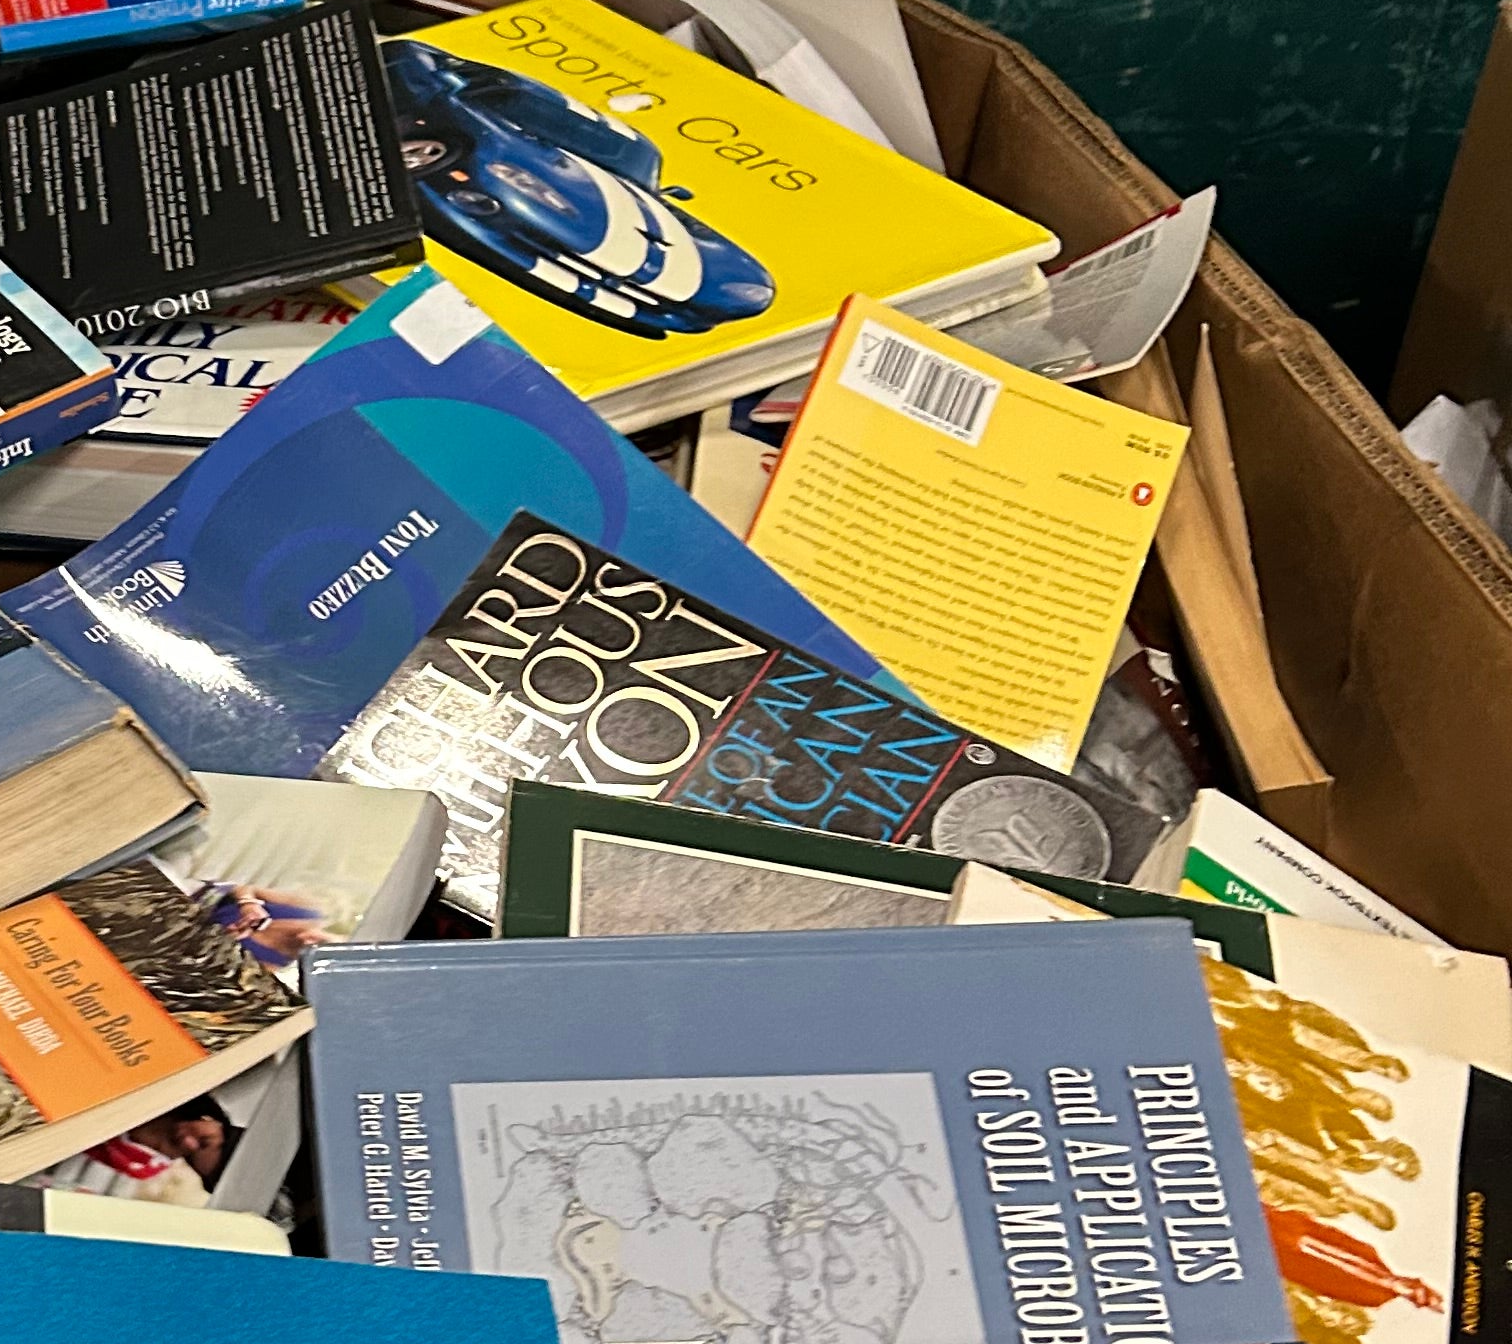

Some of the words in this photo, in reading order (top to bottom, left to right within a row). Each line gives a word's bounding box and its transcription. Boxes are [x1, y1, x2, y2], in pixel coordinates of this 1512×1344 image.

[678, 117, 818, 192] Cars
[153, 288, 211, 320] BIO
[378, 510, 439, 558] TONI
[100, 567, 154, 609] Book
[308, 550, 392, 621] BUZZEO
[338, 533, 587, 783] ICHARD
[757, 653, 830, 729] AN
[1224, 881, 1278, 912] orld
[7, 918, 60, 970] Caring
[43, 960, 83, 990] For
[64, 982, 111, 1021] Your
[93, 1014, 153, 1067] Books
[15, 1017, 64, 1055] DIRDA
[968, 1068, 1024, 1101] of
[1049, 1065, 1117, 1128] and
[357, 1093, 385, 1136] Peter
[395, 1092, 428, 1140] David
[363, 1143, 390, 1160] G.
[401, 1145, 431, 1165] M.
[978, 1109, 1053, 1193] SOIL
[1127, 1063, 1245, 1286] PRINCIPLES
[364, 1165, 398, 1220] Hartel
[401, 1169, 436, 1222] Sylvia
